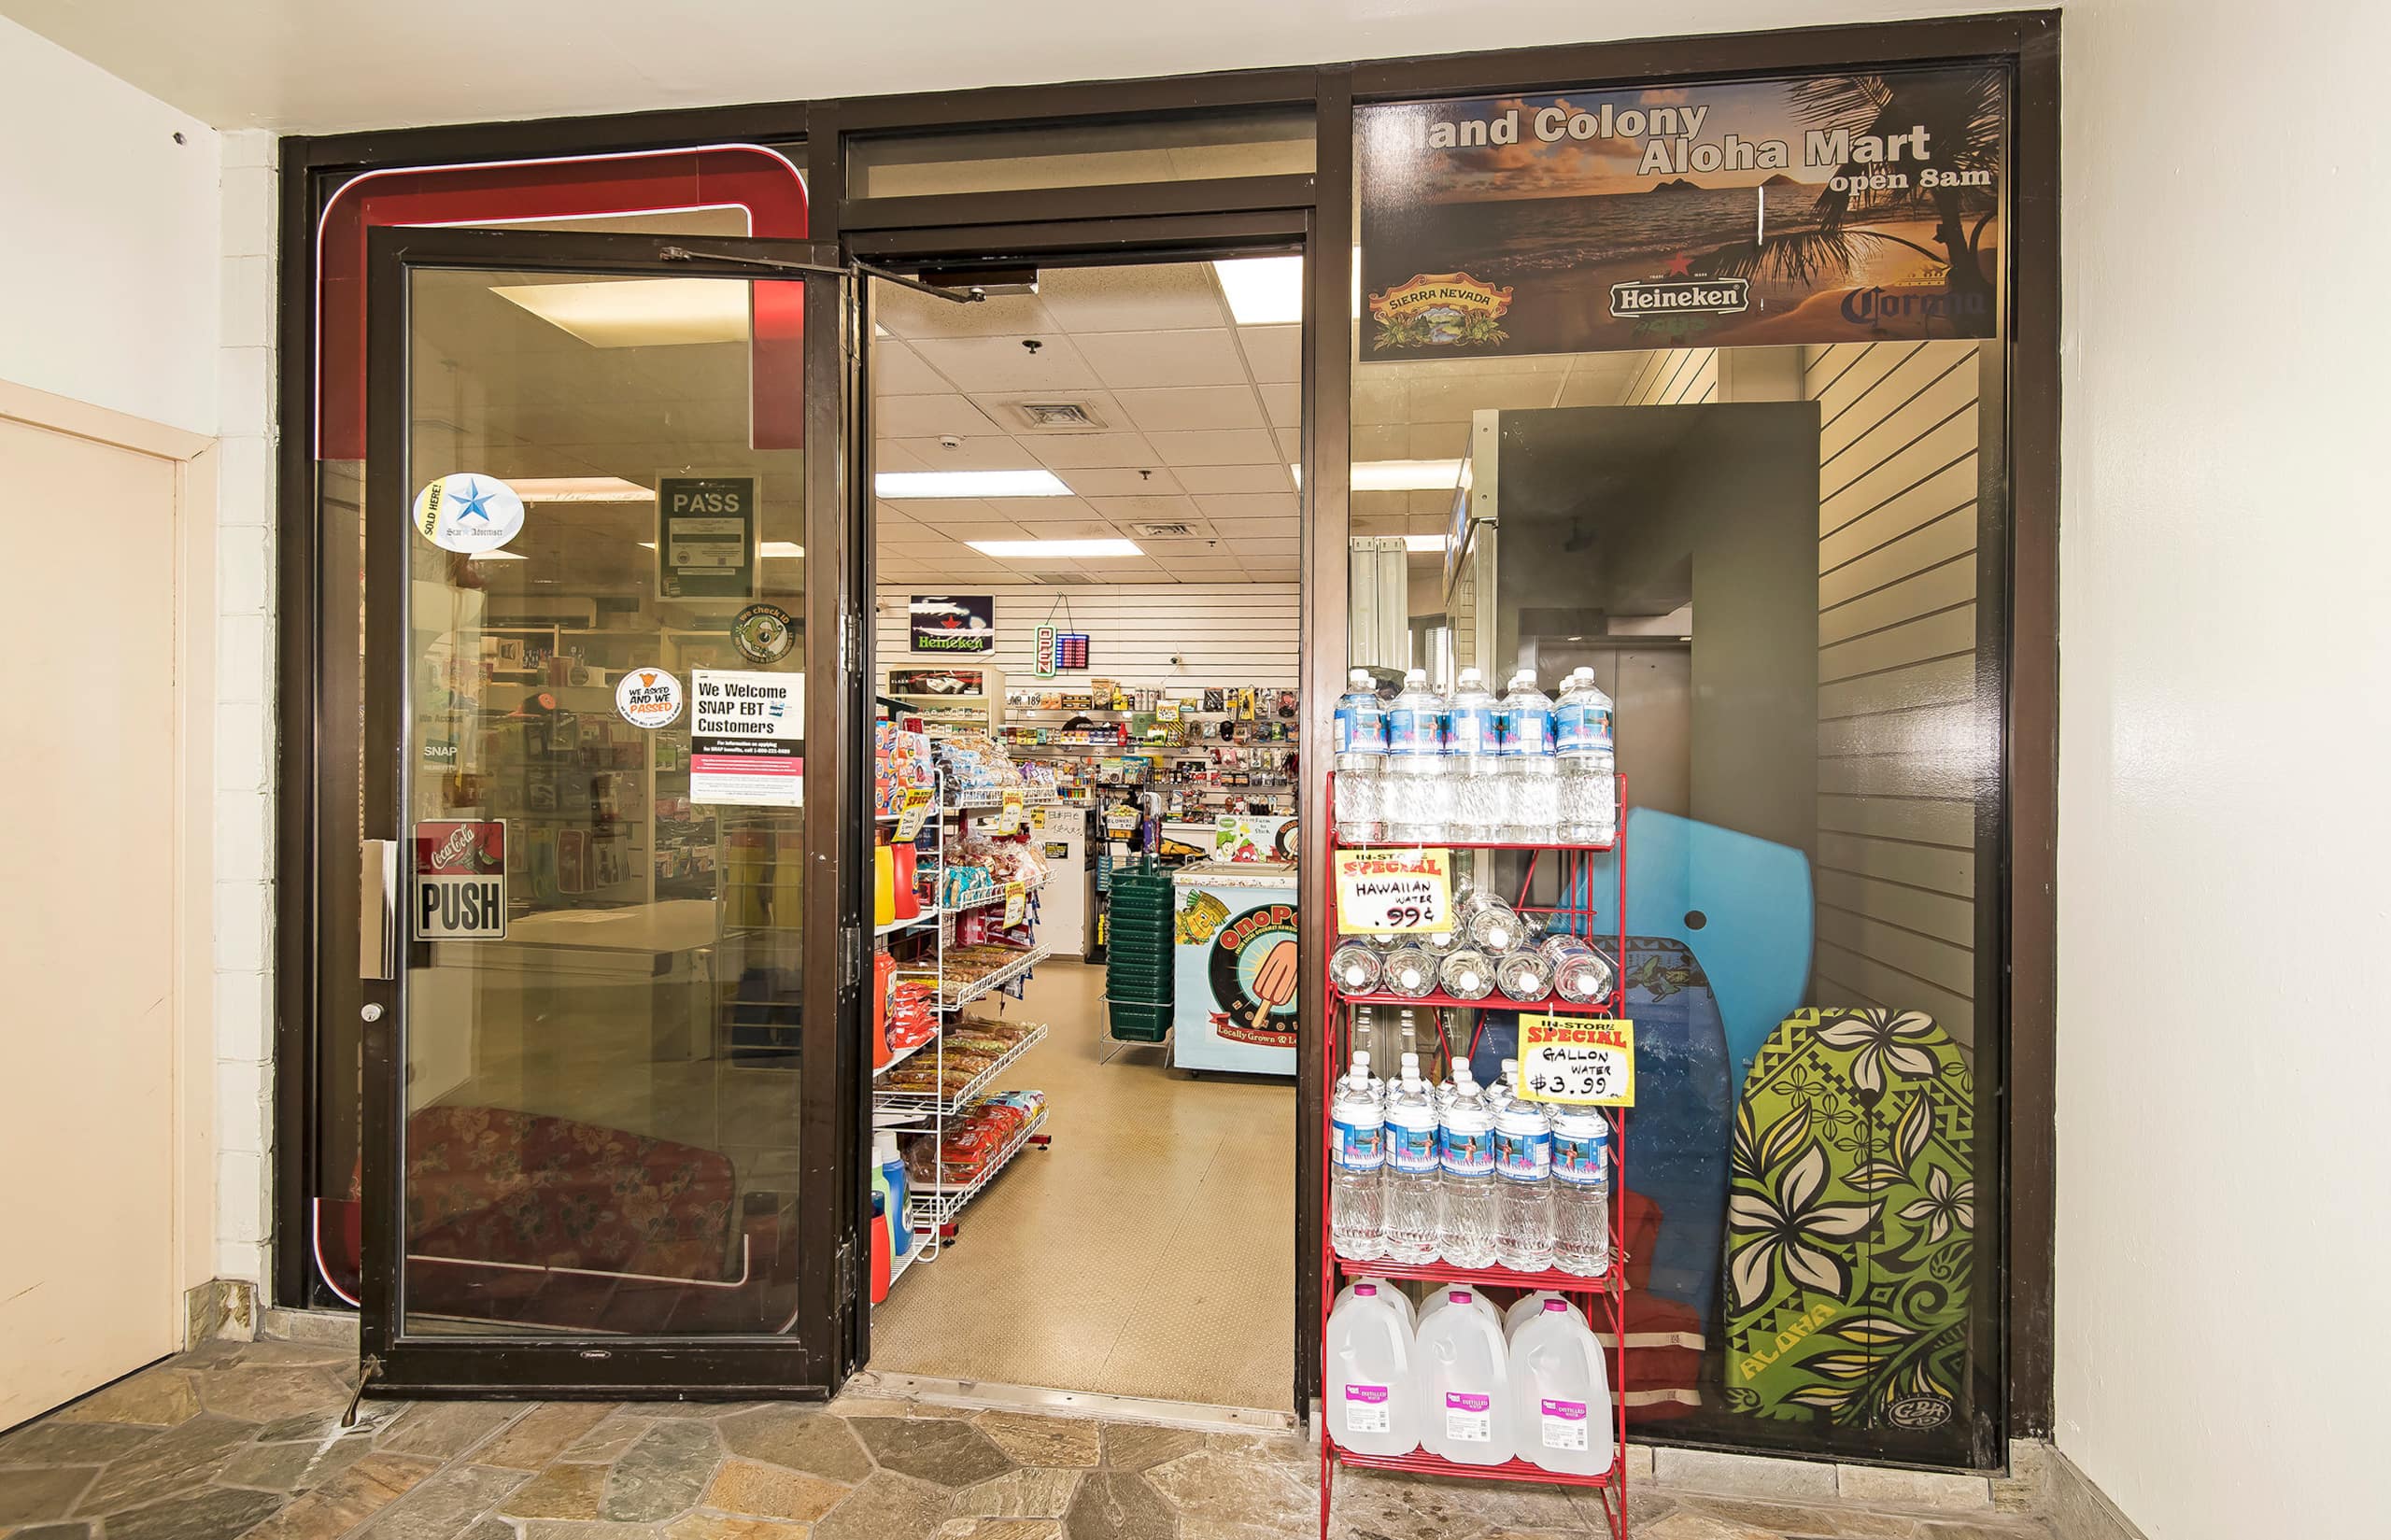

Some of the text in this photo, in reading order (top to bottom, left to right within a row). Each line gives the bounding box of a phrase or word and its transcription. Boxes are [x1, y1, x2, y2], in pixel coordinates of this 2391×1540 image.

[1533, 103, 1710, 142] Colony
[1636, 124, 1931, 176] Aloha Mart
[1829, 167, 1991, 197] open 8am
[1389, 288, 1492, 310] SIERRA NEVADA
[1620, 286, 1740, 309] Heineken
[1840, 285, 1987, 328] Corona
[424, 484, 442, 536] SOLD HERE!
[673, 493, 740, 513] PASS
[753, 606, 780, 617] check
[780, 614, 790, 625] ID
[918, 636, 983, 649] Heineken
[1038, 628, 1053, 673] OPEN
[630, 693, 671, 704] AND WE
[644, 686, 670, 695] ASKED
[699, 683, 786, 699] We Welcome
[630, 702, 672, 714] PASSED
[699, 700, 735, 714] SNAP
[740, 702, 765, 716] EBT
[698, 718, 774, 734] Customers
[423, 746, 458, 756] SNAP
[431, 823, 474, 870] Coca-Cola
[1343, 859, 1441, 876] SPECIAL
[1355, 881, 1431, 897] HAWAIIAN
[422, 883, 500, 930] PUSH
[1395, 895, 1432, 905] WATER
[1218, 1024, 1247, 1040] Locally
[1247, 1032, 1275, 1043] Grown
[1541, 1020, 1615, 1031] IN-STORE
[1527, 1026, 1627, 1049] SPECIAL
[1543, 1047, 1608, 1063] GALLON
[1571, 1065, 1611, 1076] WATER
[1530, 1072, 1606, 1097] $3.99
[1739, 1303, 1837, 1381] ALOHA
